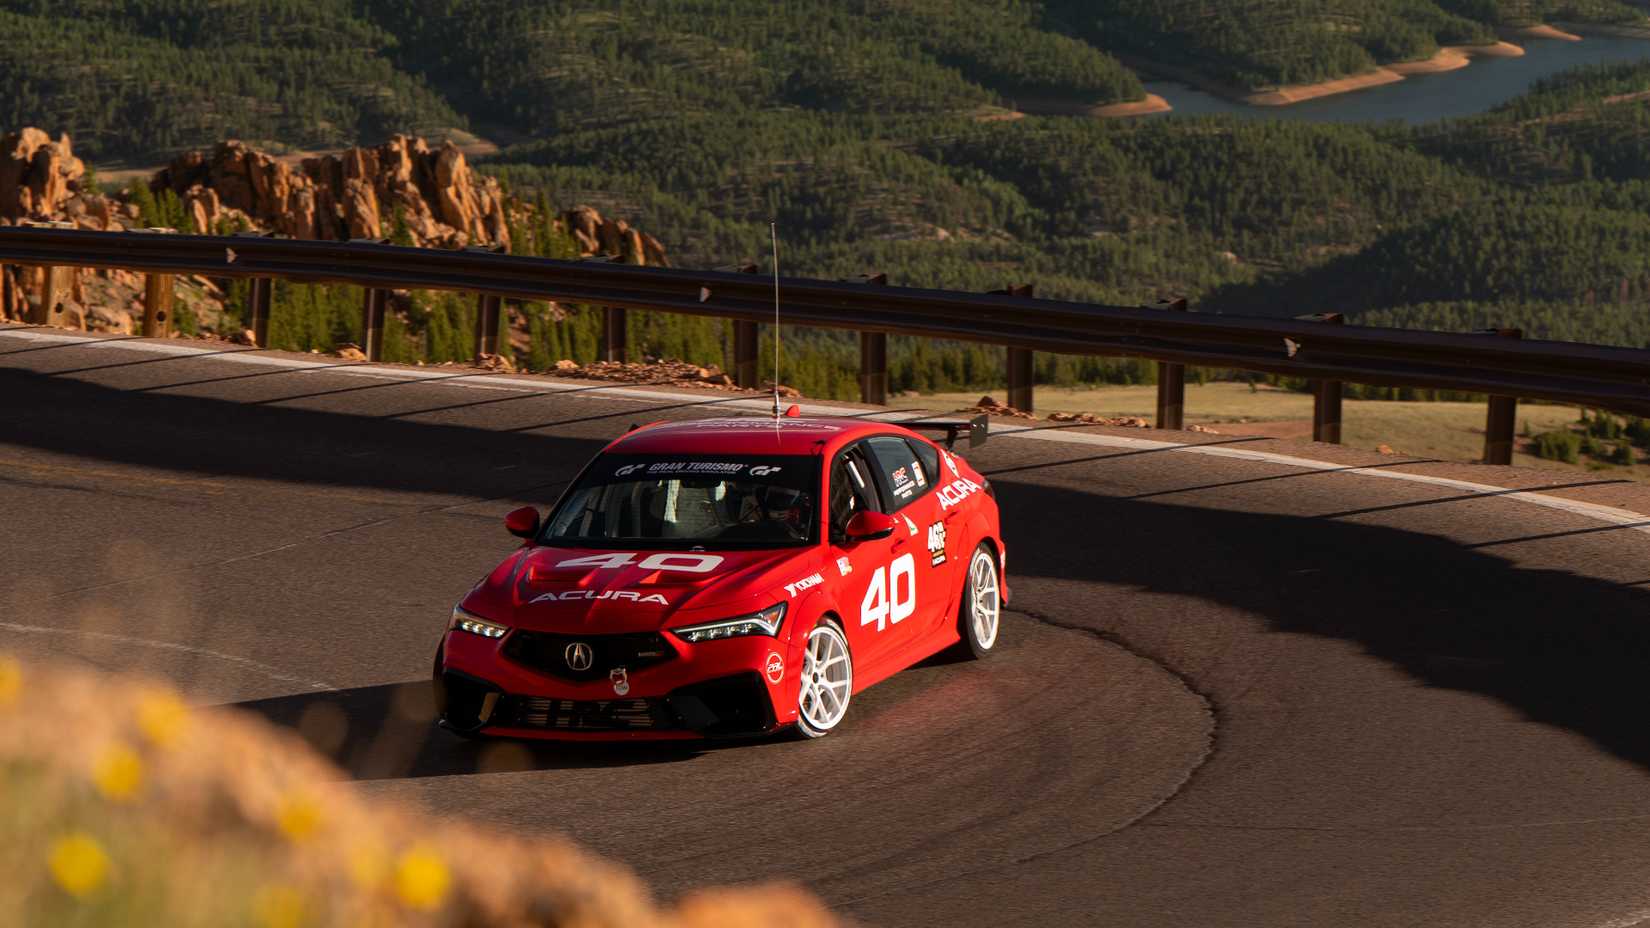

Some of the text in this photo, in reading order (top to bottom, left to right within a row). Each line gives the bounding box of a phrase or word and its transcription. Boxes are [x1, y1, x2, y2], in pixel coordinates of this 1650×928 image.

[649, 462, 742, 472] GRAN TURISMO
[936, 477, 981, 511] ACURA
[555, 553, 724, 573] 40
[527, 591, 669, 606] ACURA
[861, 553, 916, 632] 40
